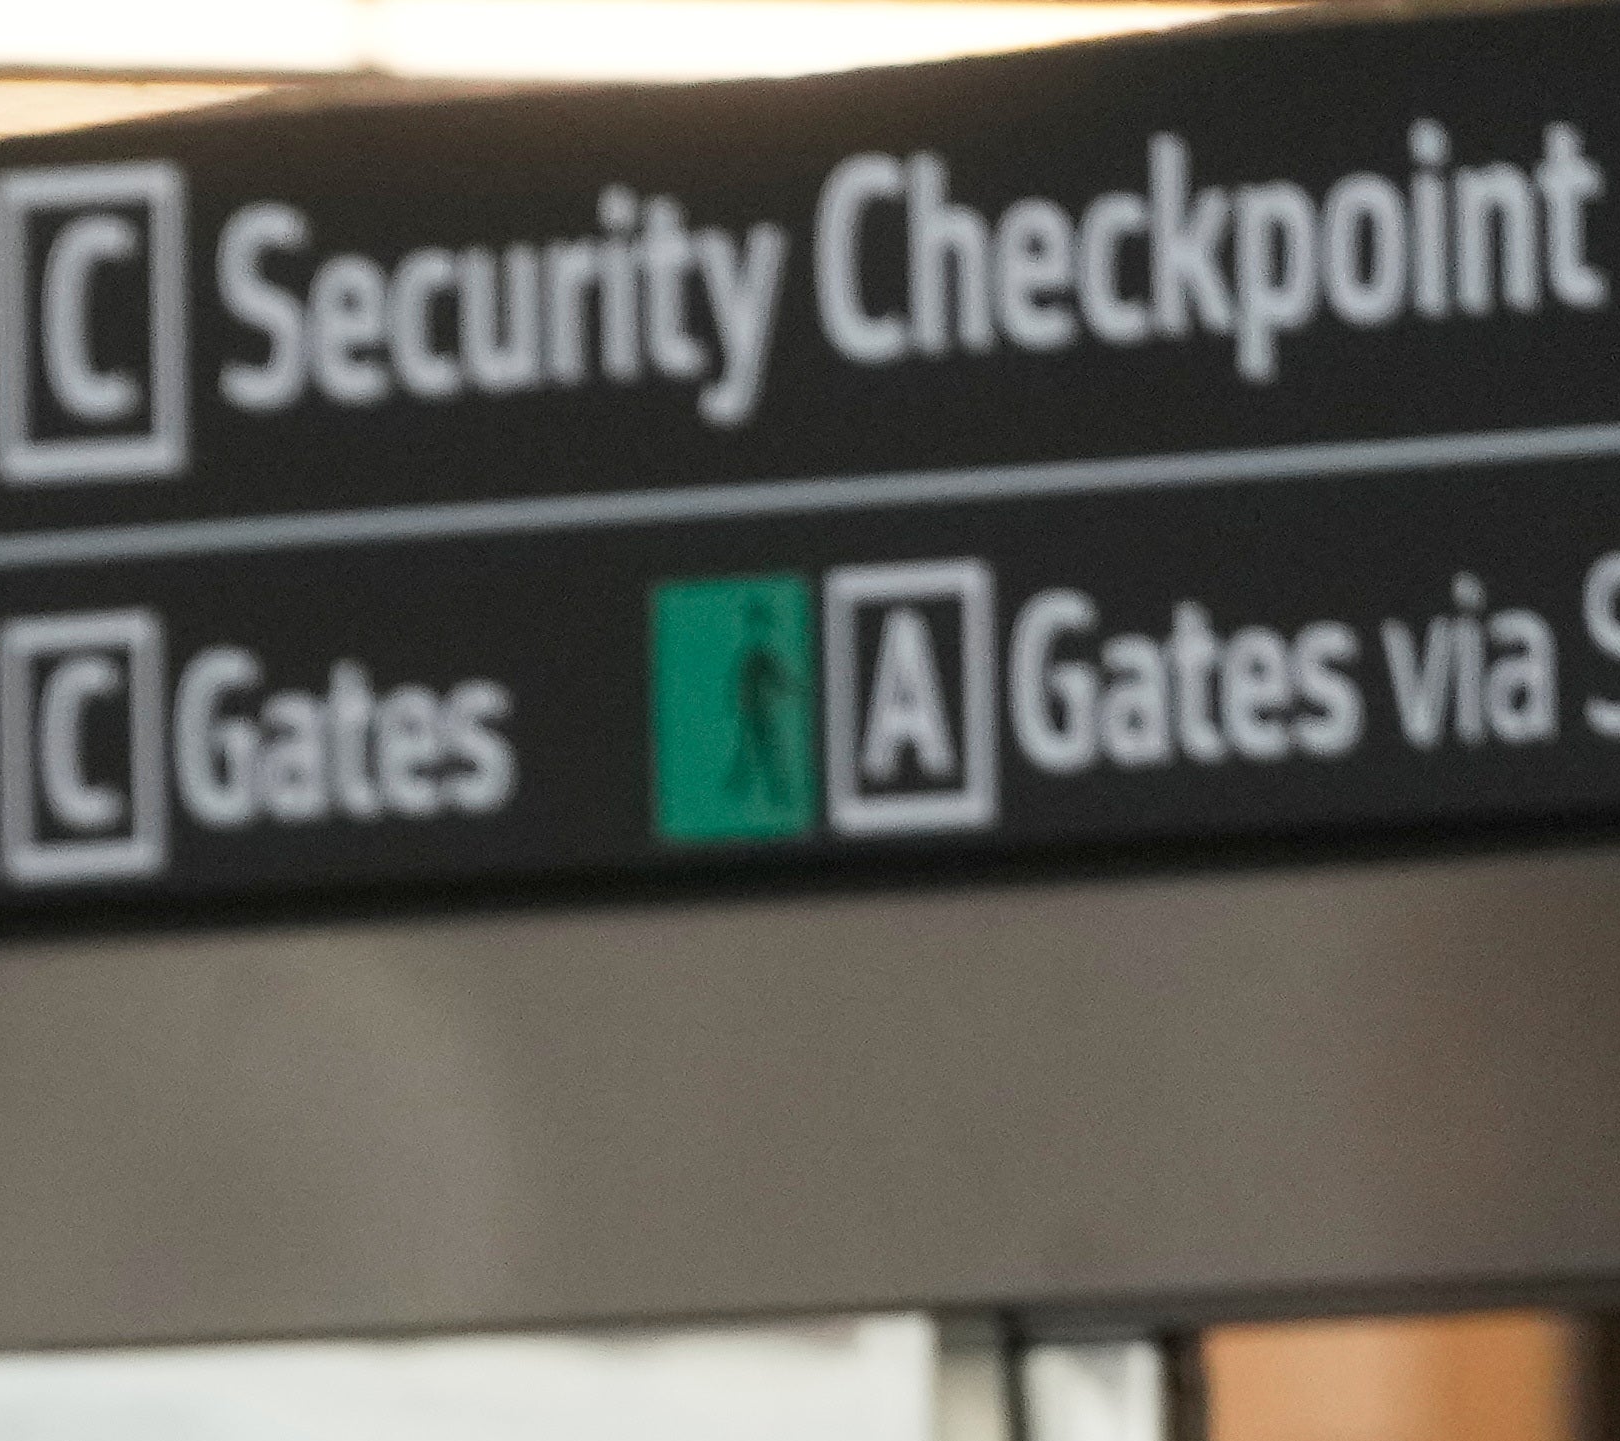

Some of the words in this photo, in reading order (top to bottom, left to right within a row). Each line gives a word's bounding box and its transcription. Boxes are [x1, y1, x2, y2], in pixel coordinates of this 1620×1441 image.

[47, 217, 133, 416] C
[220, 189, 782, 422] Security
[817, 123, 1603, 377] Checkpoint
[42, 658, 117, 826] C
[177, 650, 510, 823] Gates
[865, 613, 949, 773] A
[1012, 592, 1360, 770] Gates
[1385, 576, 1553, 743] via
